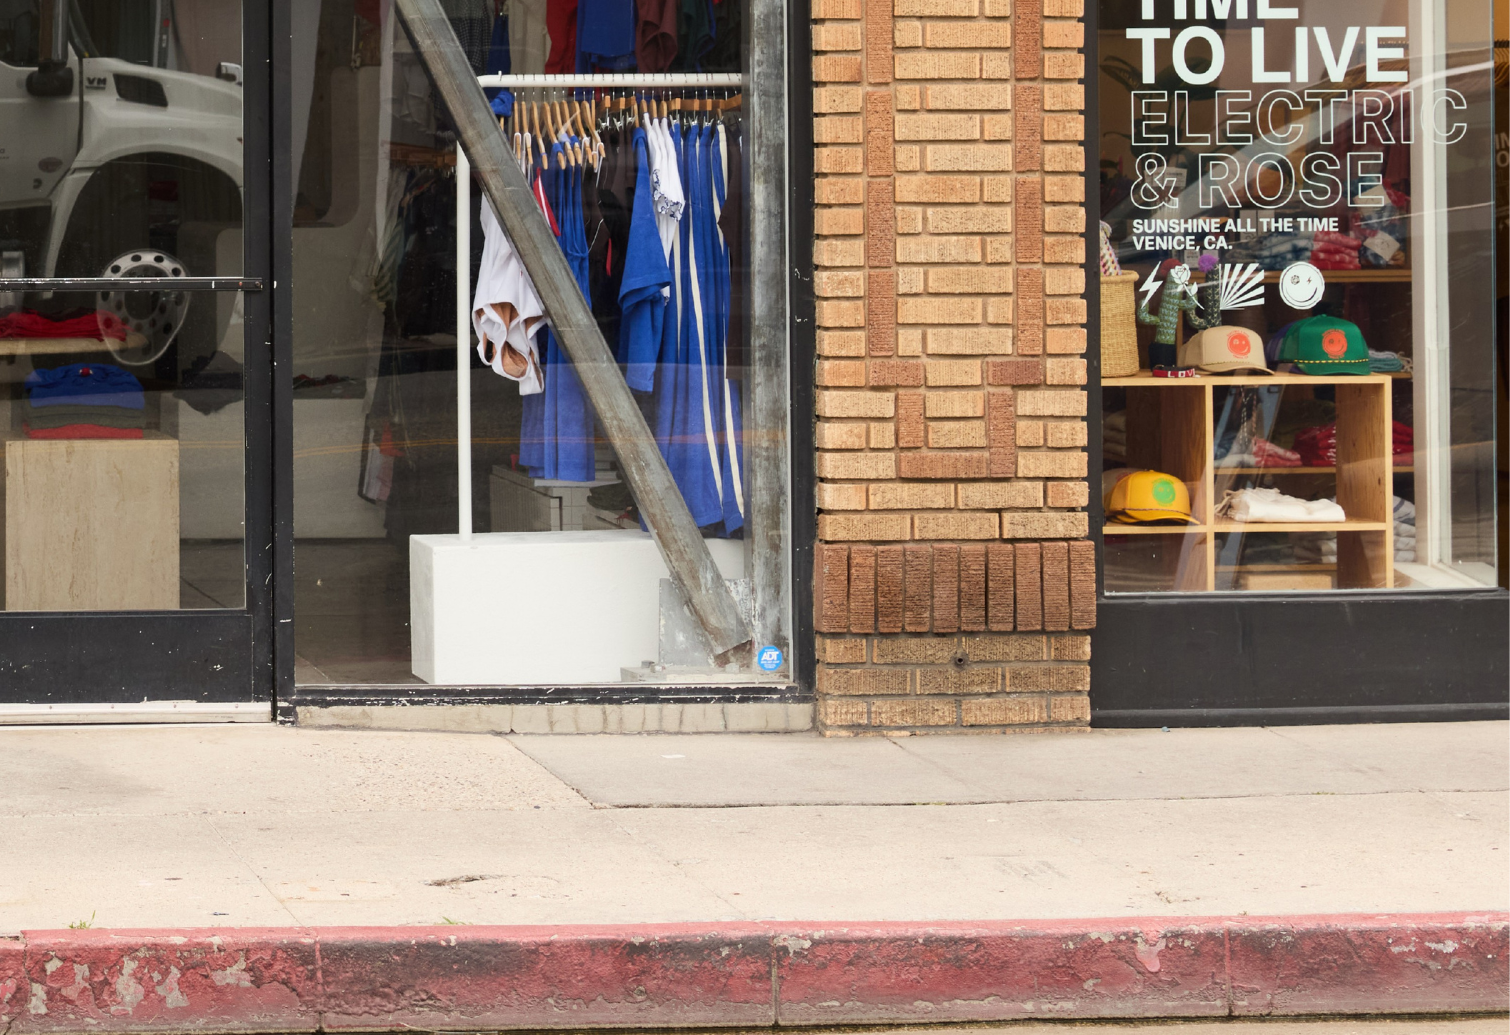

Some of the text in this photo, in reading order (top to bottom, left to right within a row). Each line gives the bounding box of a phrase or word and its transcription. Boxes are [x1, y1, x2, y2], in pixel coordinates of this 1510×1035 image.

[1125, 25, 1409, 85] TO LIVE
[1130, 89, 1468, 146] ELECTRIC
[1130, 151, 1385, 210] & ROSE
[1132, 217, 1339, 234] SUNSHINE ALL THE TIME
[1132, 235, 1233, 252] VENICE, CA.
[760, 651, 779, 661] ADT
